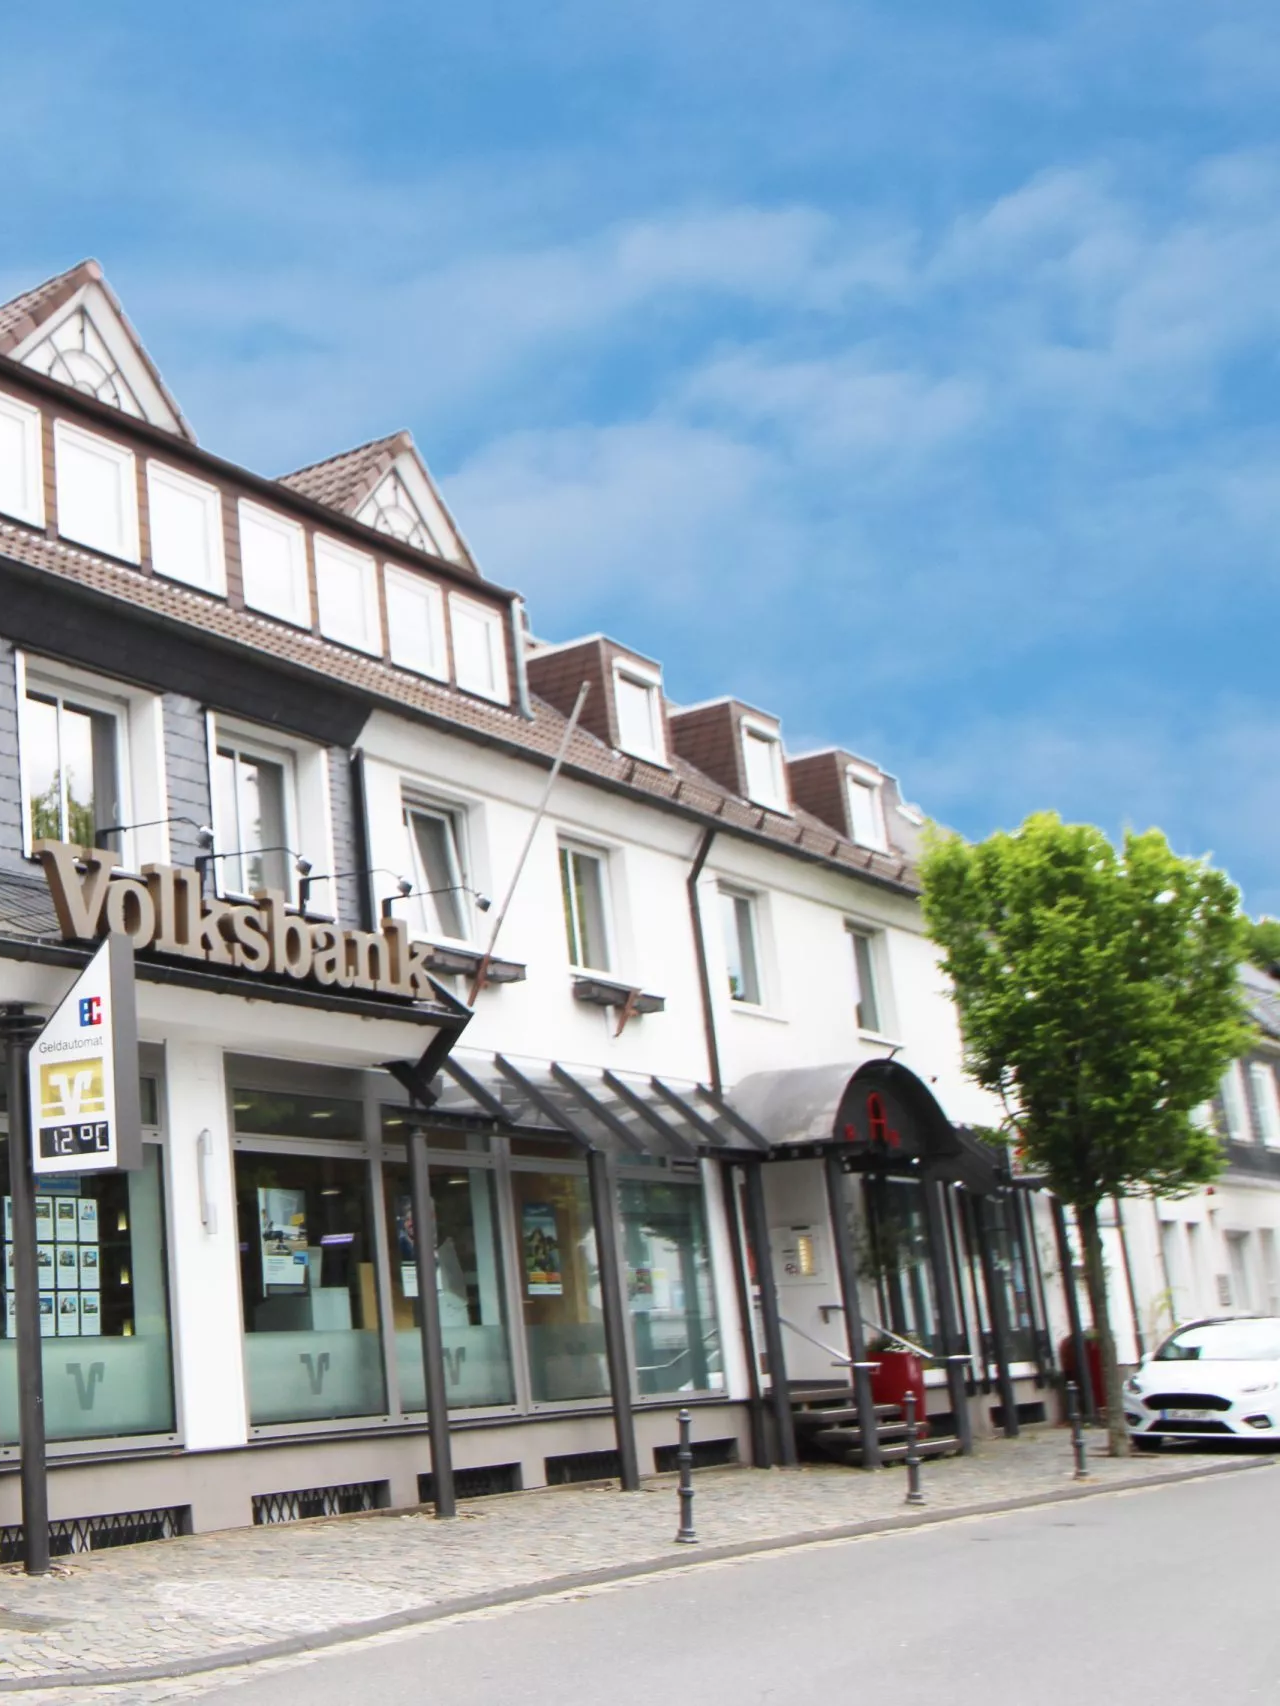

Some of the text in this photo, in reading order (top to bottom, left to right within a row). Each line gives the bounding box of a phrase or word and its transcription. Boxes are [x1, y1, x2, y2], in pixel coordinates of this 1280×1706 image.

[32, 838, 437, 1001] Volksbank
[38, 1035, 104, 1054] Geldautomat
[53, 1127, 73, 1154] 12
